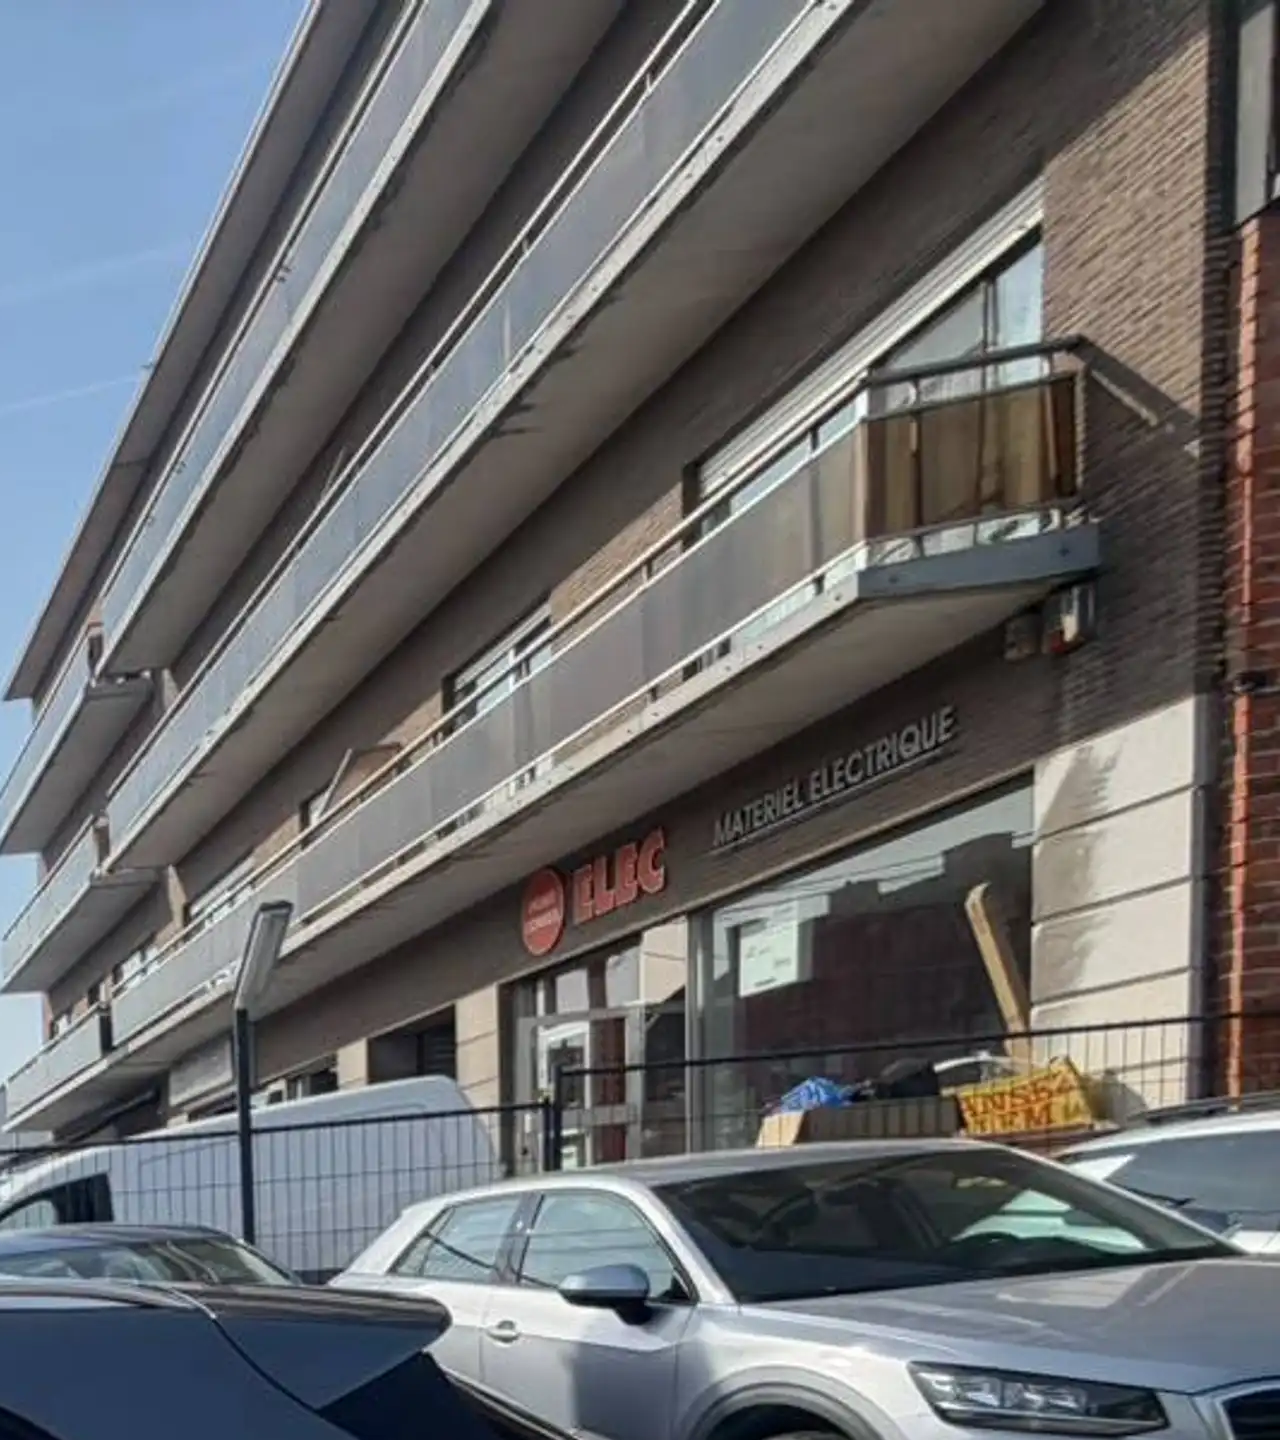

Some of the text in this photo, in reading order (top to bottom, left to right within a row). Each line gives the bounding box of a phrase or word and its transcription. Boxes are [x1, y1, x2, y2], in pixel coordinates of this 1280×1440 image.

[713, 704, 958, 847] MATERIEL ELECTRIQUE
[572, 826, 665, 926] ELEC
